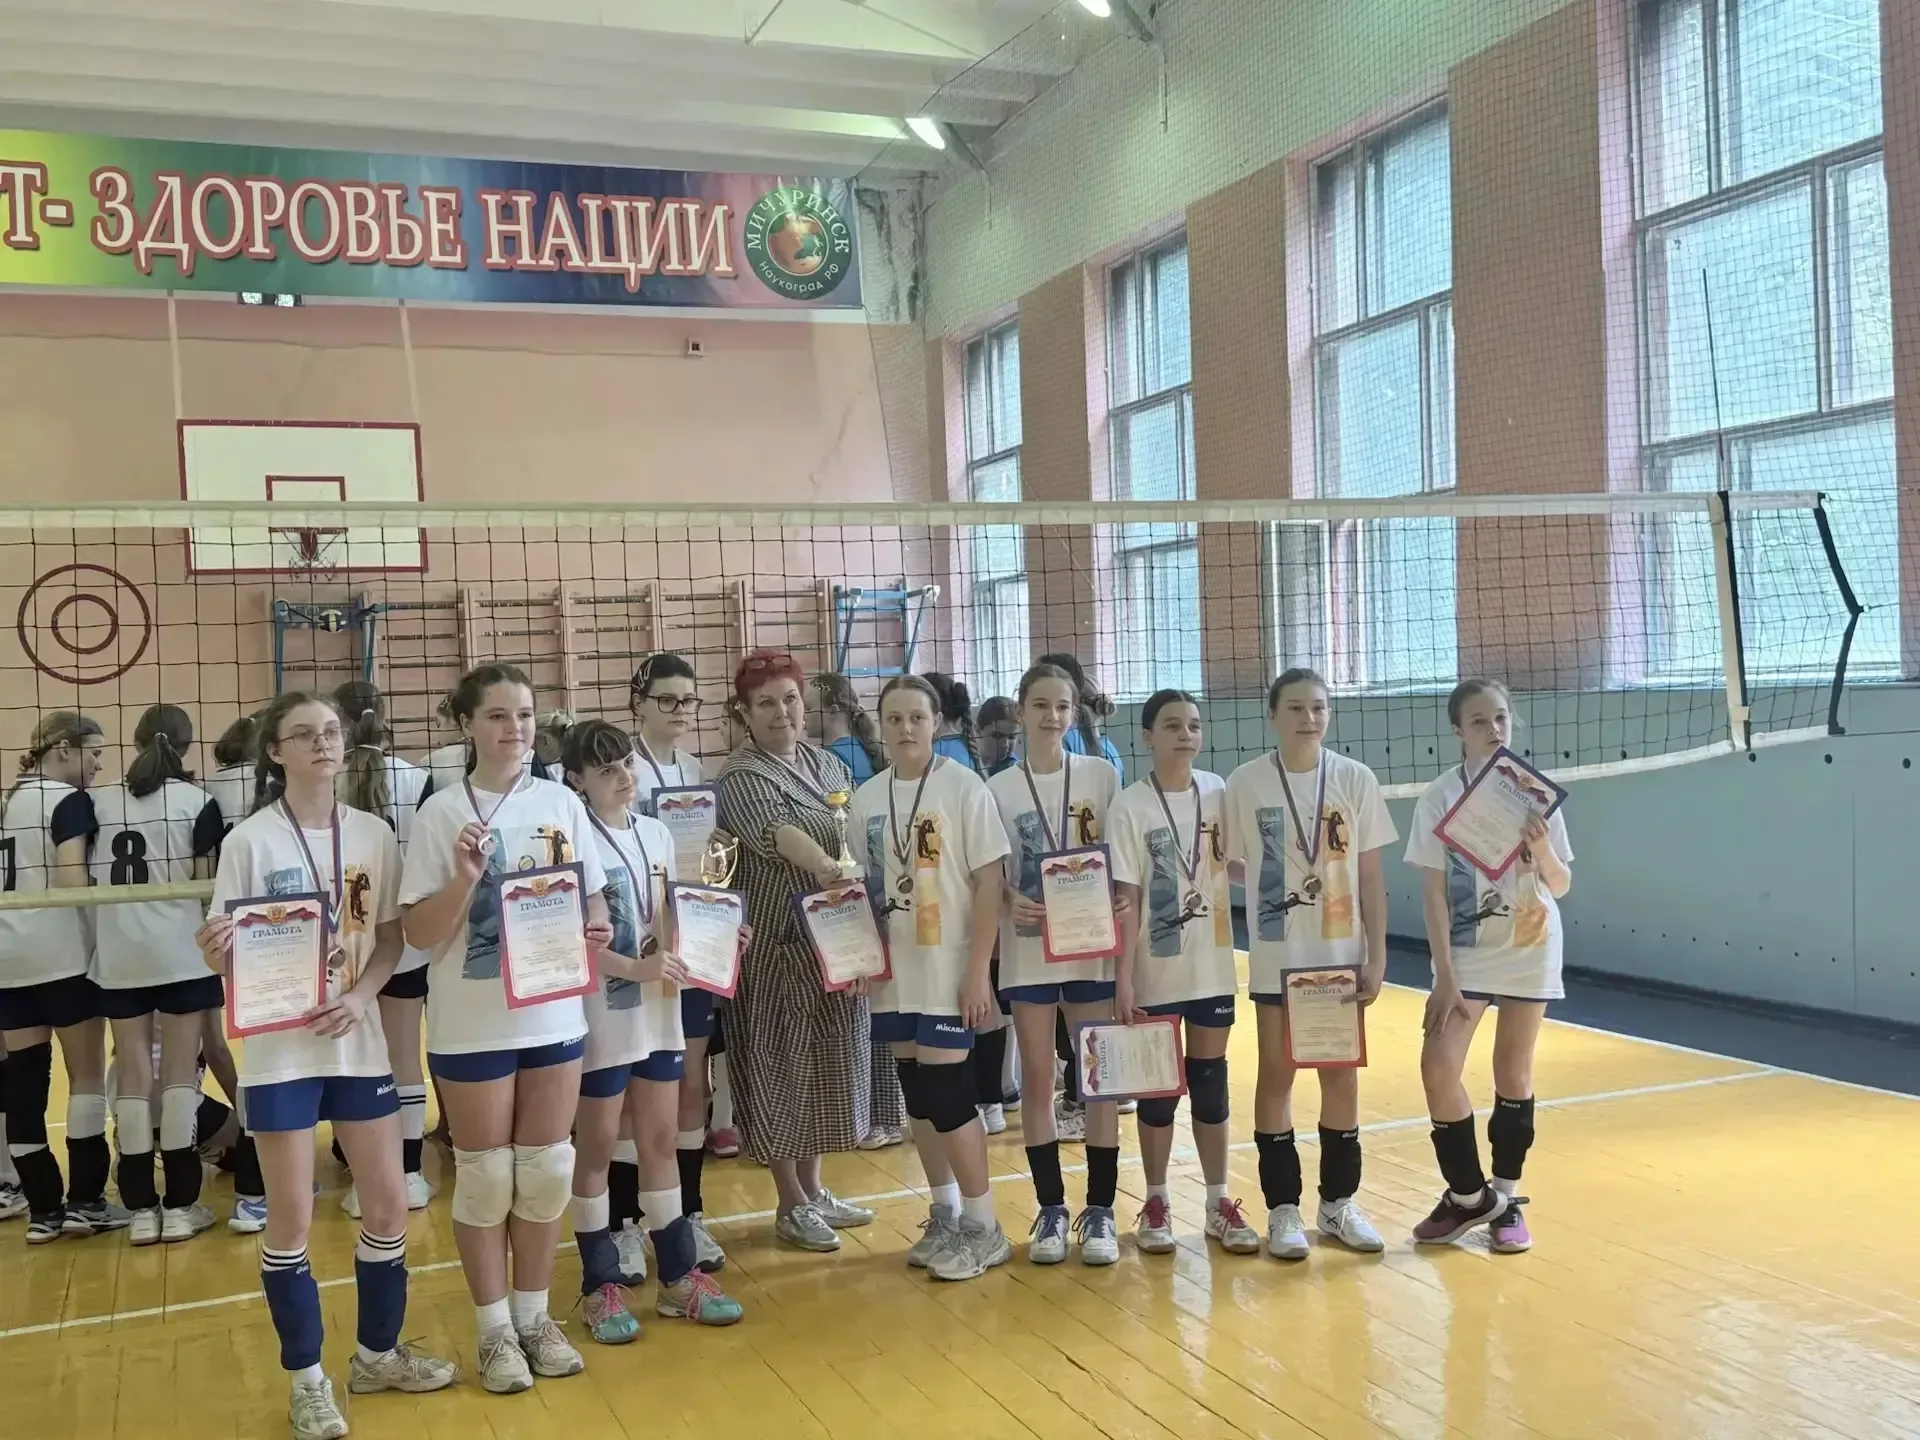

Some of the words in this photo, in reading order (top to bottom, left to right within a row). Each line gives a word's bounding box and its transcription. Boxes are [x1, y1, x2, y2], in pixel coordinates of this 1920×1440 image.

[92, 168, 465, 274] ЗДОРОВЬЕ
[479, 191, 736, 289] НАЦИИ
[746, 189, 850, 254] МИЧУРИНСК
[1498, 779, 1533, 808] ГРАМОТА
[671, 812, 705, 821] ГРАМОТА
[110, 830, 149, 886] 8
[1057, 873, 1095, 885] ГРАМОТА
[520, 897, 564, 911] ГРАМОТА
[691, 904, 730, 916] ГРАМОТА
[820, 905, 857, 920] ГРАМОТА
[252, 926, 302, 939] ГРАМОТА
[1303, 987, 1342, 997] ГРАМОТА
[1100, 1039, 1109, 1080] ГРАМОТА
